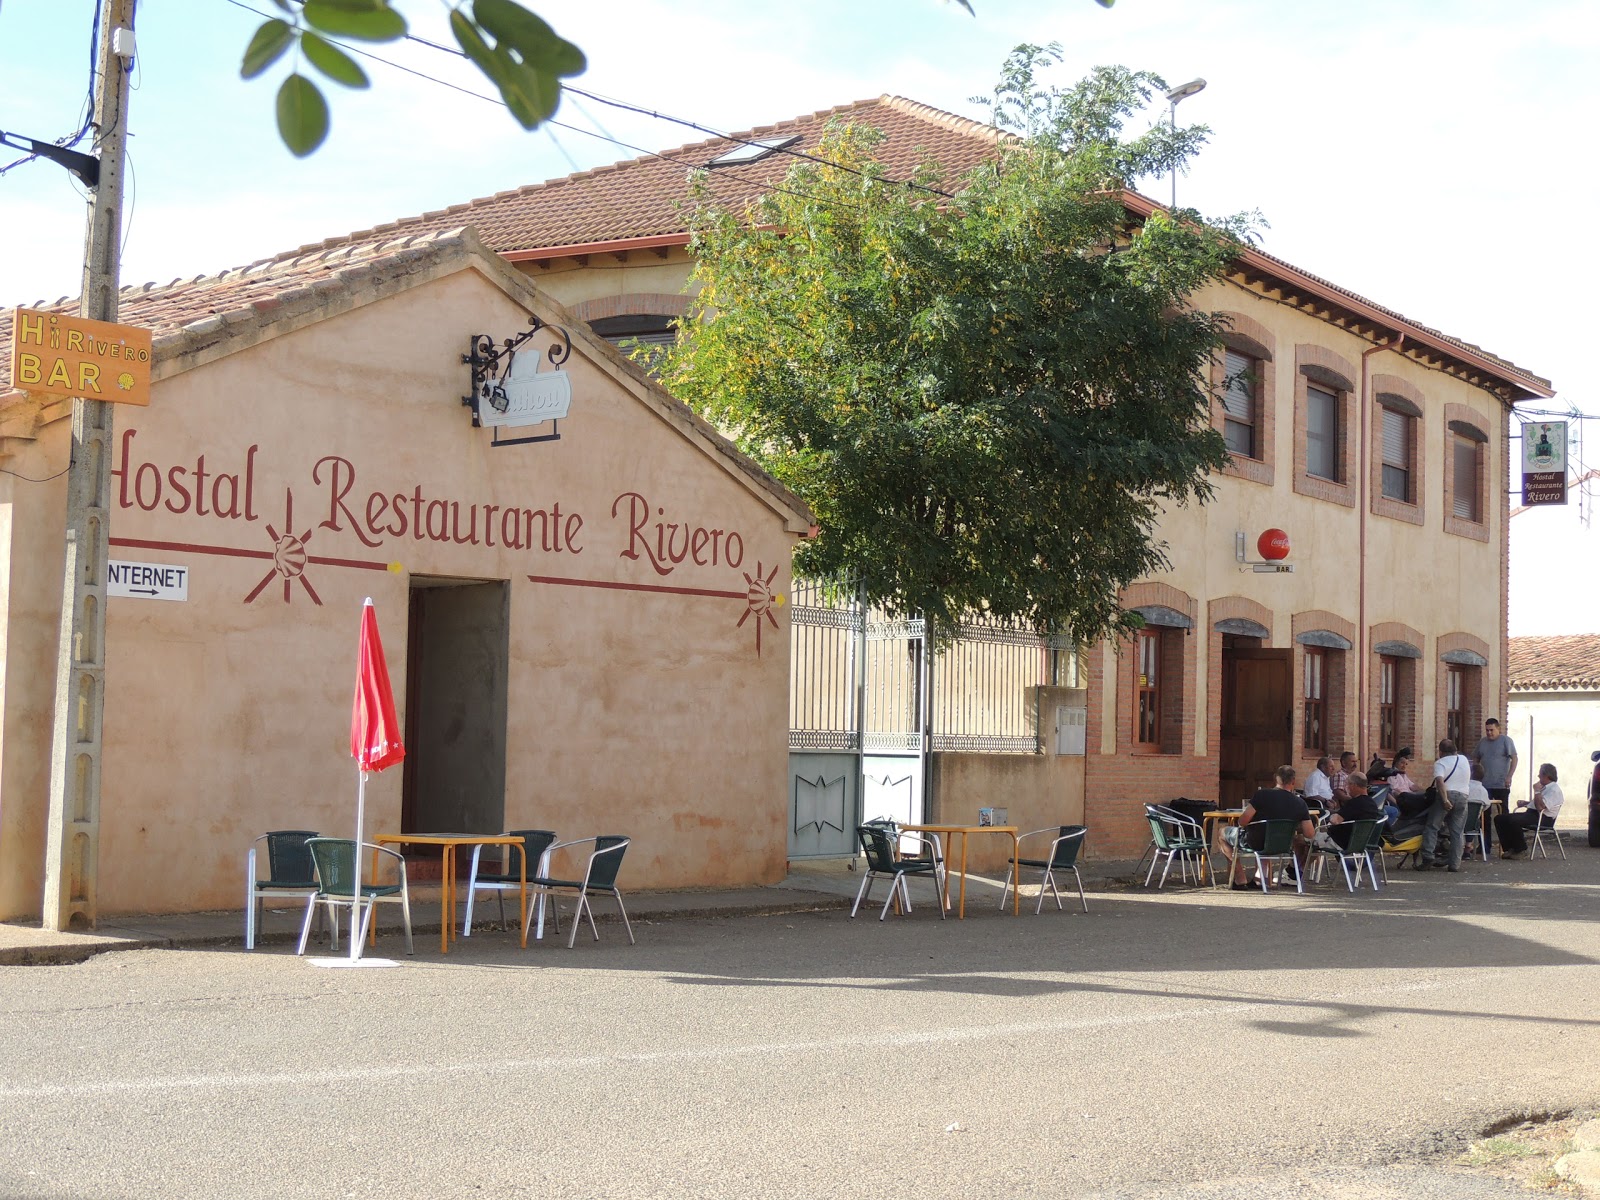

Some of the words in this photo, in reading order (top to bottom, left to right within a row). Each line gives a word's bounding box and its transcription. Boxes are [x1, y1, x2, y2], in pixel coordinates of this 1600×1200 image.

[19, 353, 102, 393] BAR
[1532, 472, 1555, 481] Hostal
[1524, 482, 1563, 491] Restaurante
[1527, 492, 1560, 502] Rivero
[312, 455, 584, 554] Restaurante
[611, 491, 744, 576] Rivero
[108, 564, 186, 588] NTERNET
